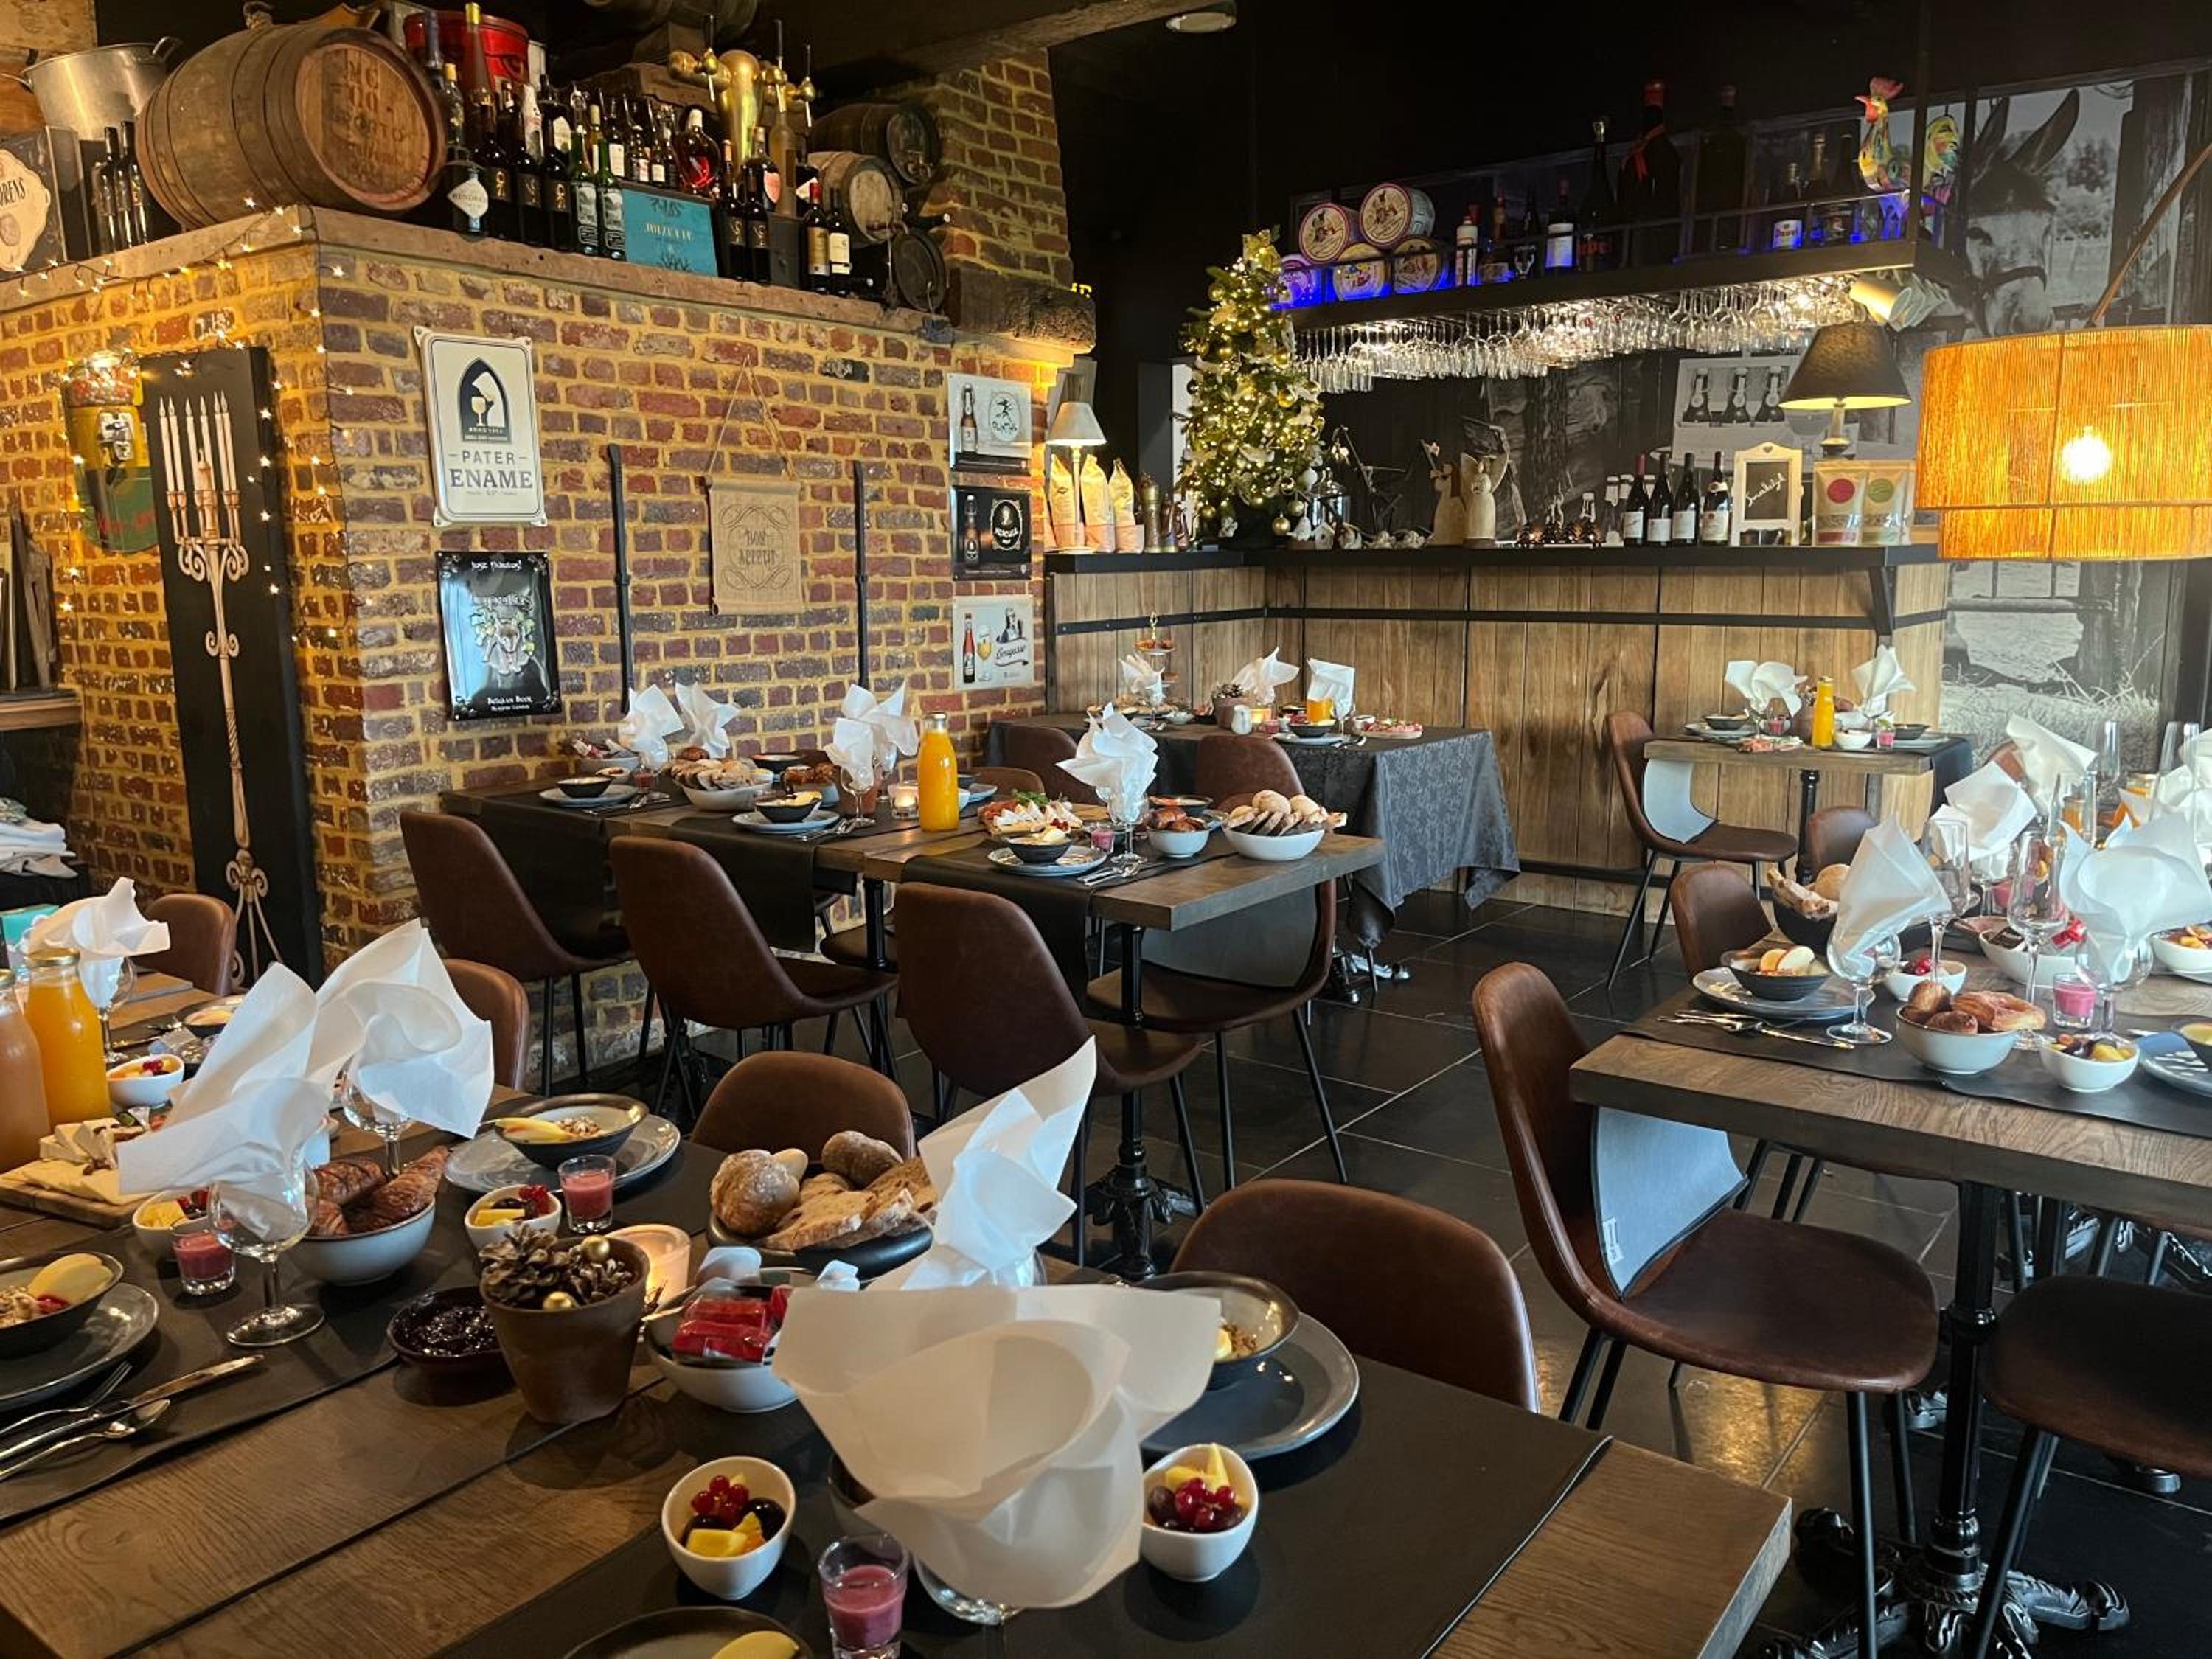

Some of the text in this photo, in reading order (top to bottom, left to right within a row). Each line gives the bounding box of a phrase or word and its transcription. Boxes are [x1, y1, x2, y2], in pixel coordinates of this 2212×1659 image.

[0, 176, 26, 207] RENS
[462, 450, 515, 465] PATER
[449, 468, 533, 489] ENAME
